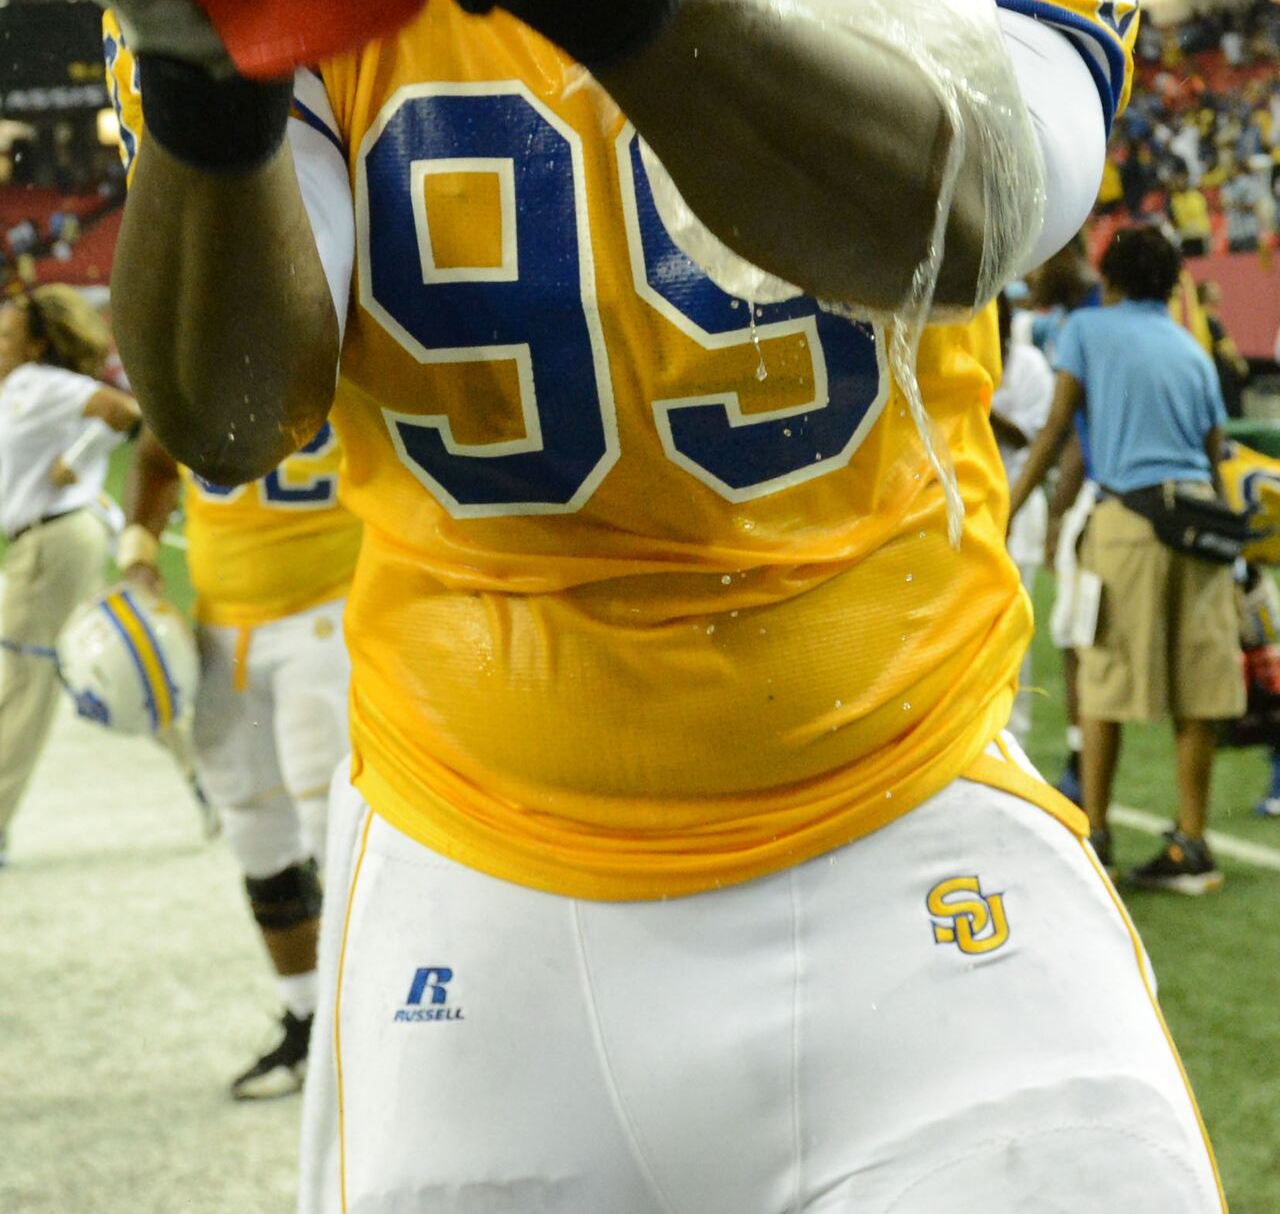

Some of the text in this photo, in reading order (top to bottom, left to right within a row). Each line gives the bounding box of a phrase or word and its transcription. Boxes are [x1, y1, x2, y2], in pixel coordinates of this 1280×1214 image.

[356, 80, 891, 519] 99
[925, 875, 1009, 956] SU
[393, 1007, 465, 1023] RUSSELL
